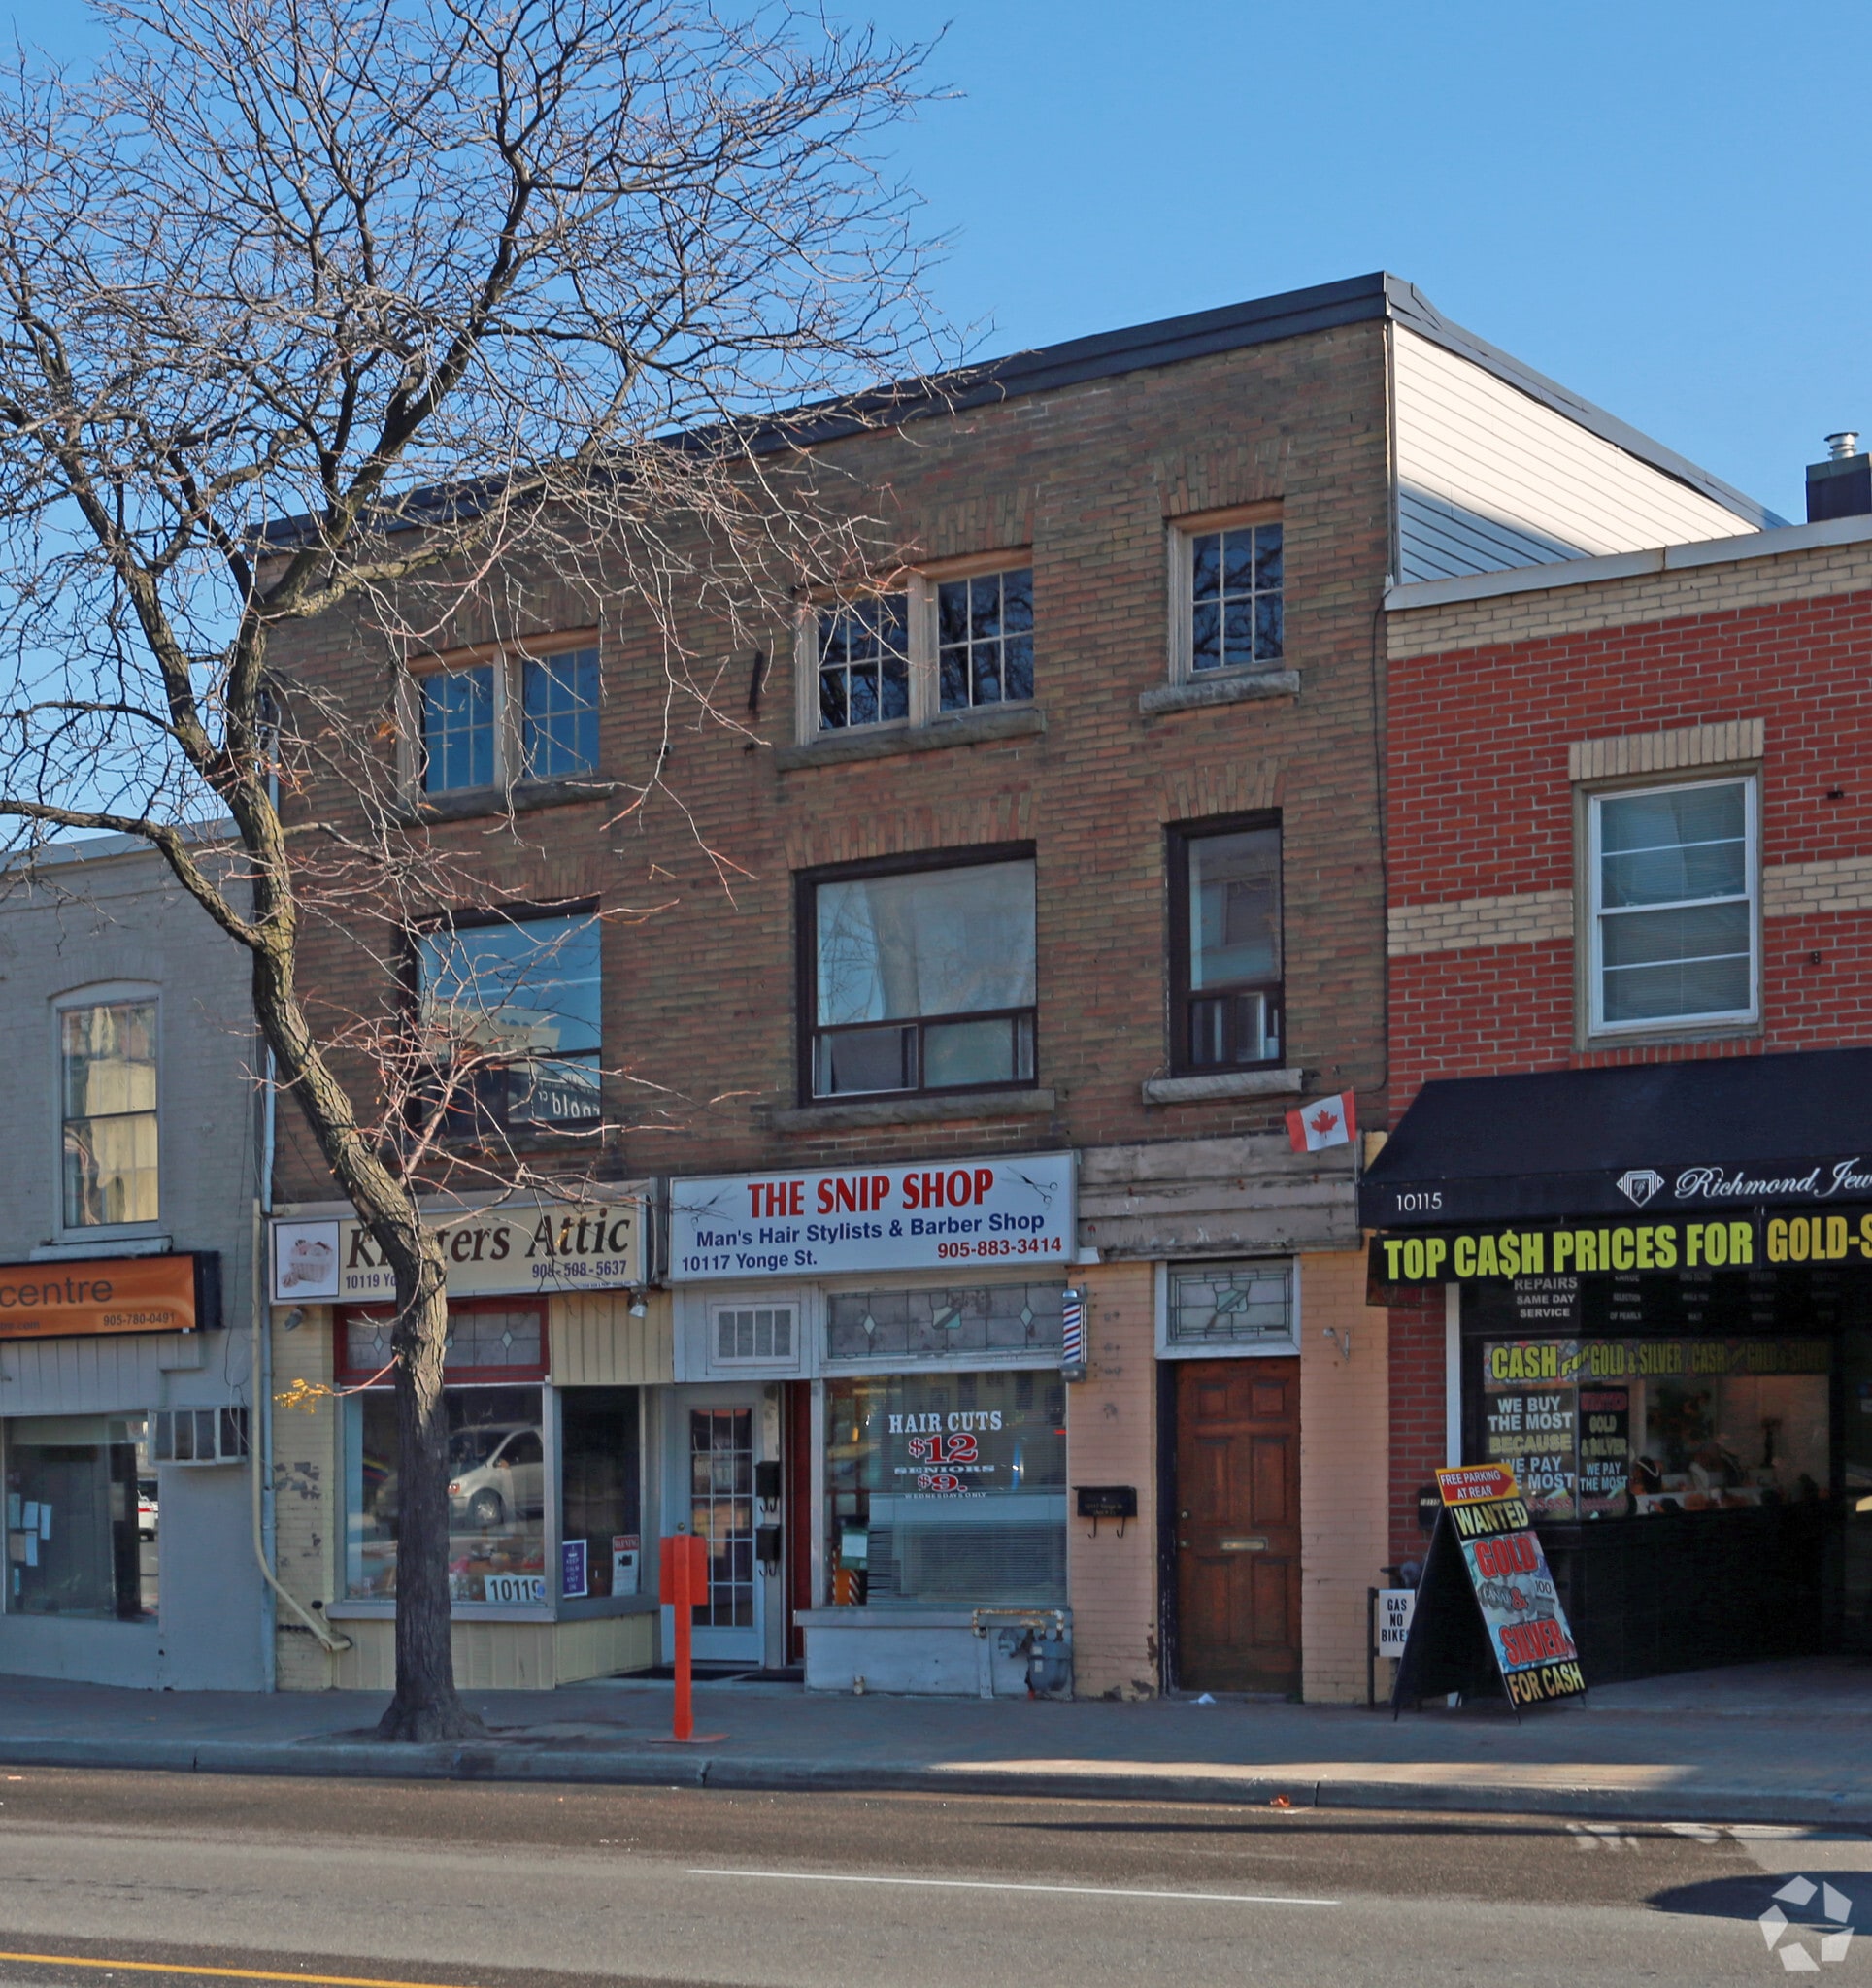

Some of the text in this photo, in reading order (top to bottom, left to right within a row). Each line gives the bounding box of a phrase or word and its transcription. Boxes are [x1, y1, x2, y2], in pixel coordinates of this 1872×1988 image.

[1673, 1167, 1821, 1199] Richmond
[747, 1169, 994, 1218] THE SNIP SHOP
[1396, 1192, 1443, 1211] 10115
[525, 1207, 631, 1258] Attic
[696, 1213, 1045, 1247] Man's Hair Stylists & Barber Shop
[937, 1237, 1062, 1259] 905-883-3414
[1383, 1239, 1447, 1280] TOP
[1454, 1229, 1544, 1279] CA$H
[1554, 1224, 1677, 1273] PRICES
[1686, 1221, 1753, 1266] FOR
[532, 1260, 627, 1278] 905-508-5637
[682, 1249, 818, 1273] 10117 Yonge St.
[345, 1274, 380, 1290] 10119
[1514, 1277, 1578, 1291] REPAIRS
[0, 1276, 114, 1308] centre
[1516, 1294, 1576, 1305] SAME DAY
[103, 1312, 176, 1327] 905-780-0491
[1520, 1308, 1570, 1318] SERVICE
[1490, 1345, 1557, 1380] CASH
[1590, 1342, 1625, 1375] GOLD
[1627, 1353, 1637, 1374] &
[1639, 1342, 1682, 1374] SILVER
[1497, 1396, 1561, 1413] WE BUY
[888, 1411, 1002, 1434] HAIR CUTS
[1487, 1412, 1573, 1431] THE MOST
[1588, 1415, 1618, 1434] GOLD
[909, 1434, 978, 1464] $12
[1489, 1433, 1573, 1454] BECAUSE
[894, 1465, 995, 1474] SENIORS
[1530, 1456, 1562, 1472] PAY
[1586, 1462, 1621, 1475] WE PAY
[1440, 1473, 1463, 1486] FREE
[1463, 1470, 1501, 1484] PARKING
[1528, 1473, 1575, 1489] MOST
[1580, 1476, 1628, 1491] THE MOST
[1456, 1486, 1492, 1500] AT REAR
[1454, 1501, 1529, 1536] WANTED
[1473, 1537, 1538, 1579] GOLD
[1535, 1579, 1552, 1594] 100
[1387, 1598, 1407, 1611] GAS
[1510, 1587, 1529, 1610] &
[1389, 1613, 1403, 1627] NO
[1499, 1619, 1566, 1665] SILVER
[1507, 1662, 1585, 1705] FOR CASH
